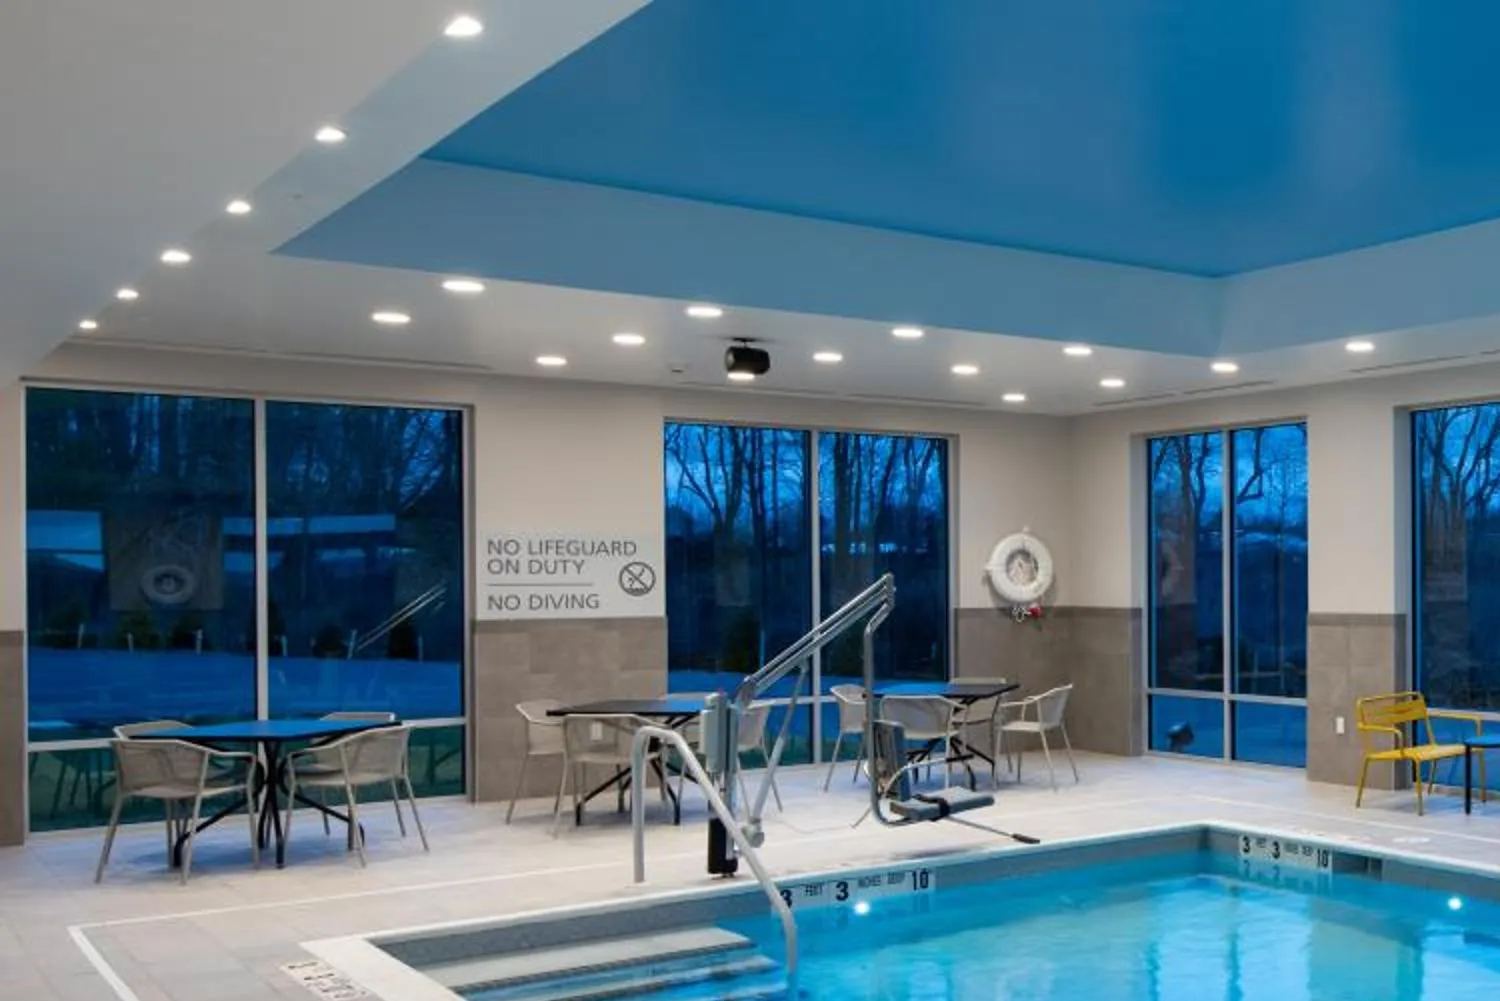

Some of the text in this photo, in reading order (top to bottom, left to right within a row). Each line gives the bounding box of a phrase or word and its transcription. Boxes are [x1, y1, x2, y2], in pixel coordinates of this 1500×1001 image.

[487, 539, 637, 557] NO LIFEGUARD
[487, 559, 584, 575] ON DUTY
[487, 593, 600, 610] NO DIVING
[836, 881, 849, 901] 3
